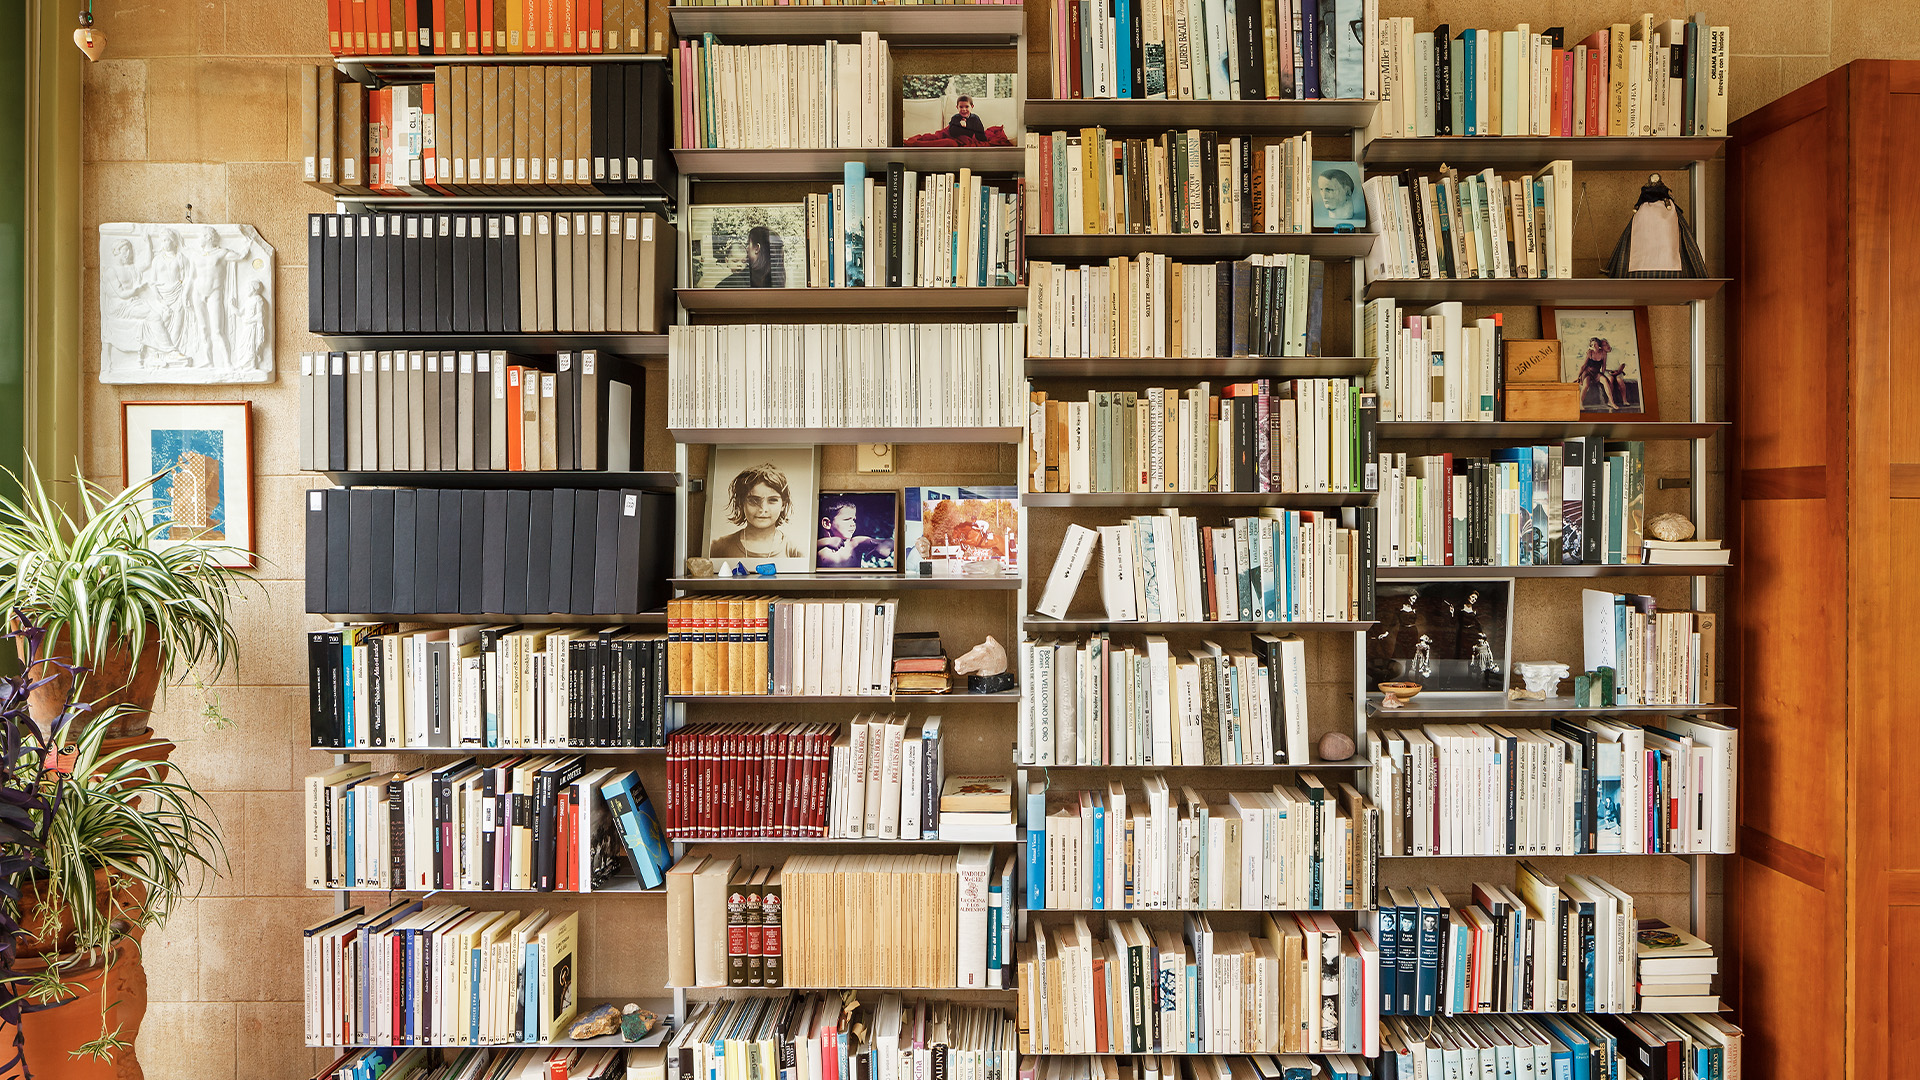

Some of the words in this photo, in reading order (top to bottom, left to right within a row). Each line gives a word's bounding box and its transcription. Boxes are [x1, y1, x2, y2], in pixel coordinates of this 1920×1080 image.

[1177, 17, 1187, 42] BACALL
[1178, 43, 1188, 69] LAUREN
[1381, 48, 1390, 73] Miller
[1382, 74, 1392, 102] Henry
[1514, 362, 1531, 376] 250
[1540, 346, 1553, 358] Net
[1158, 436, 1163, 444] DE
[1042, 717, 1049, 726] DE
